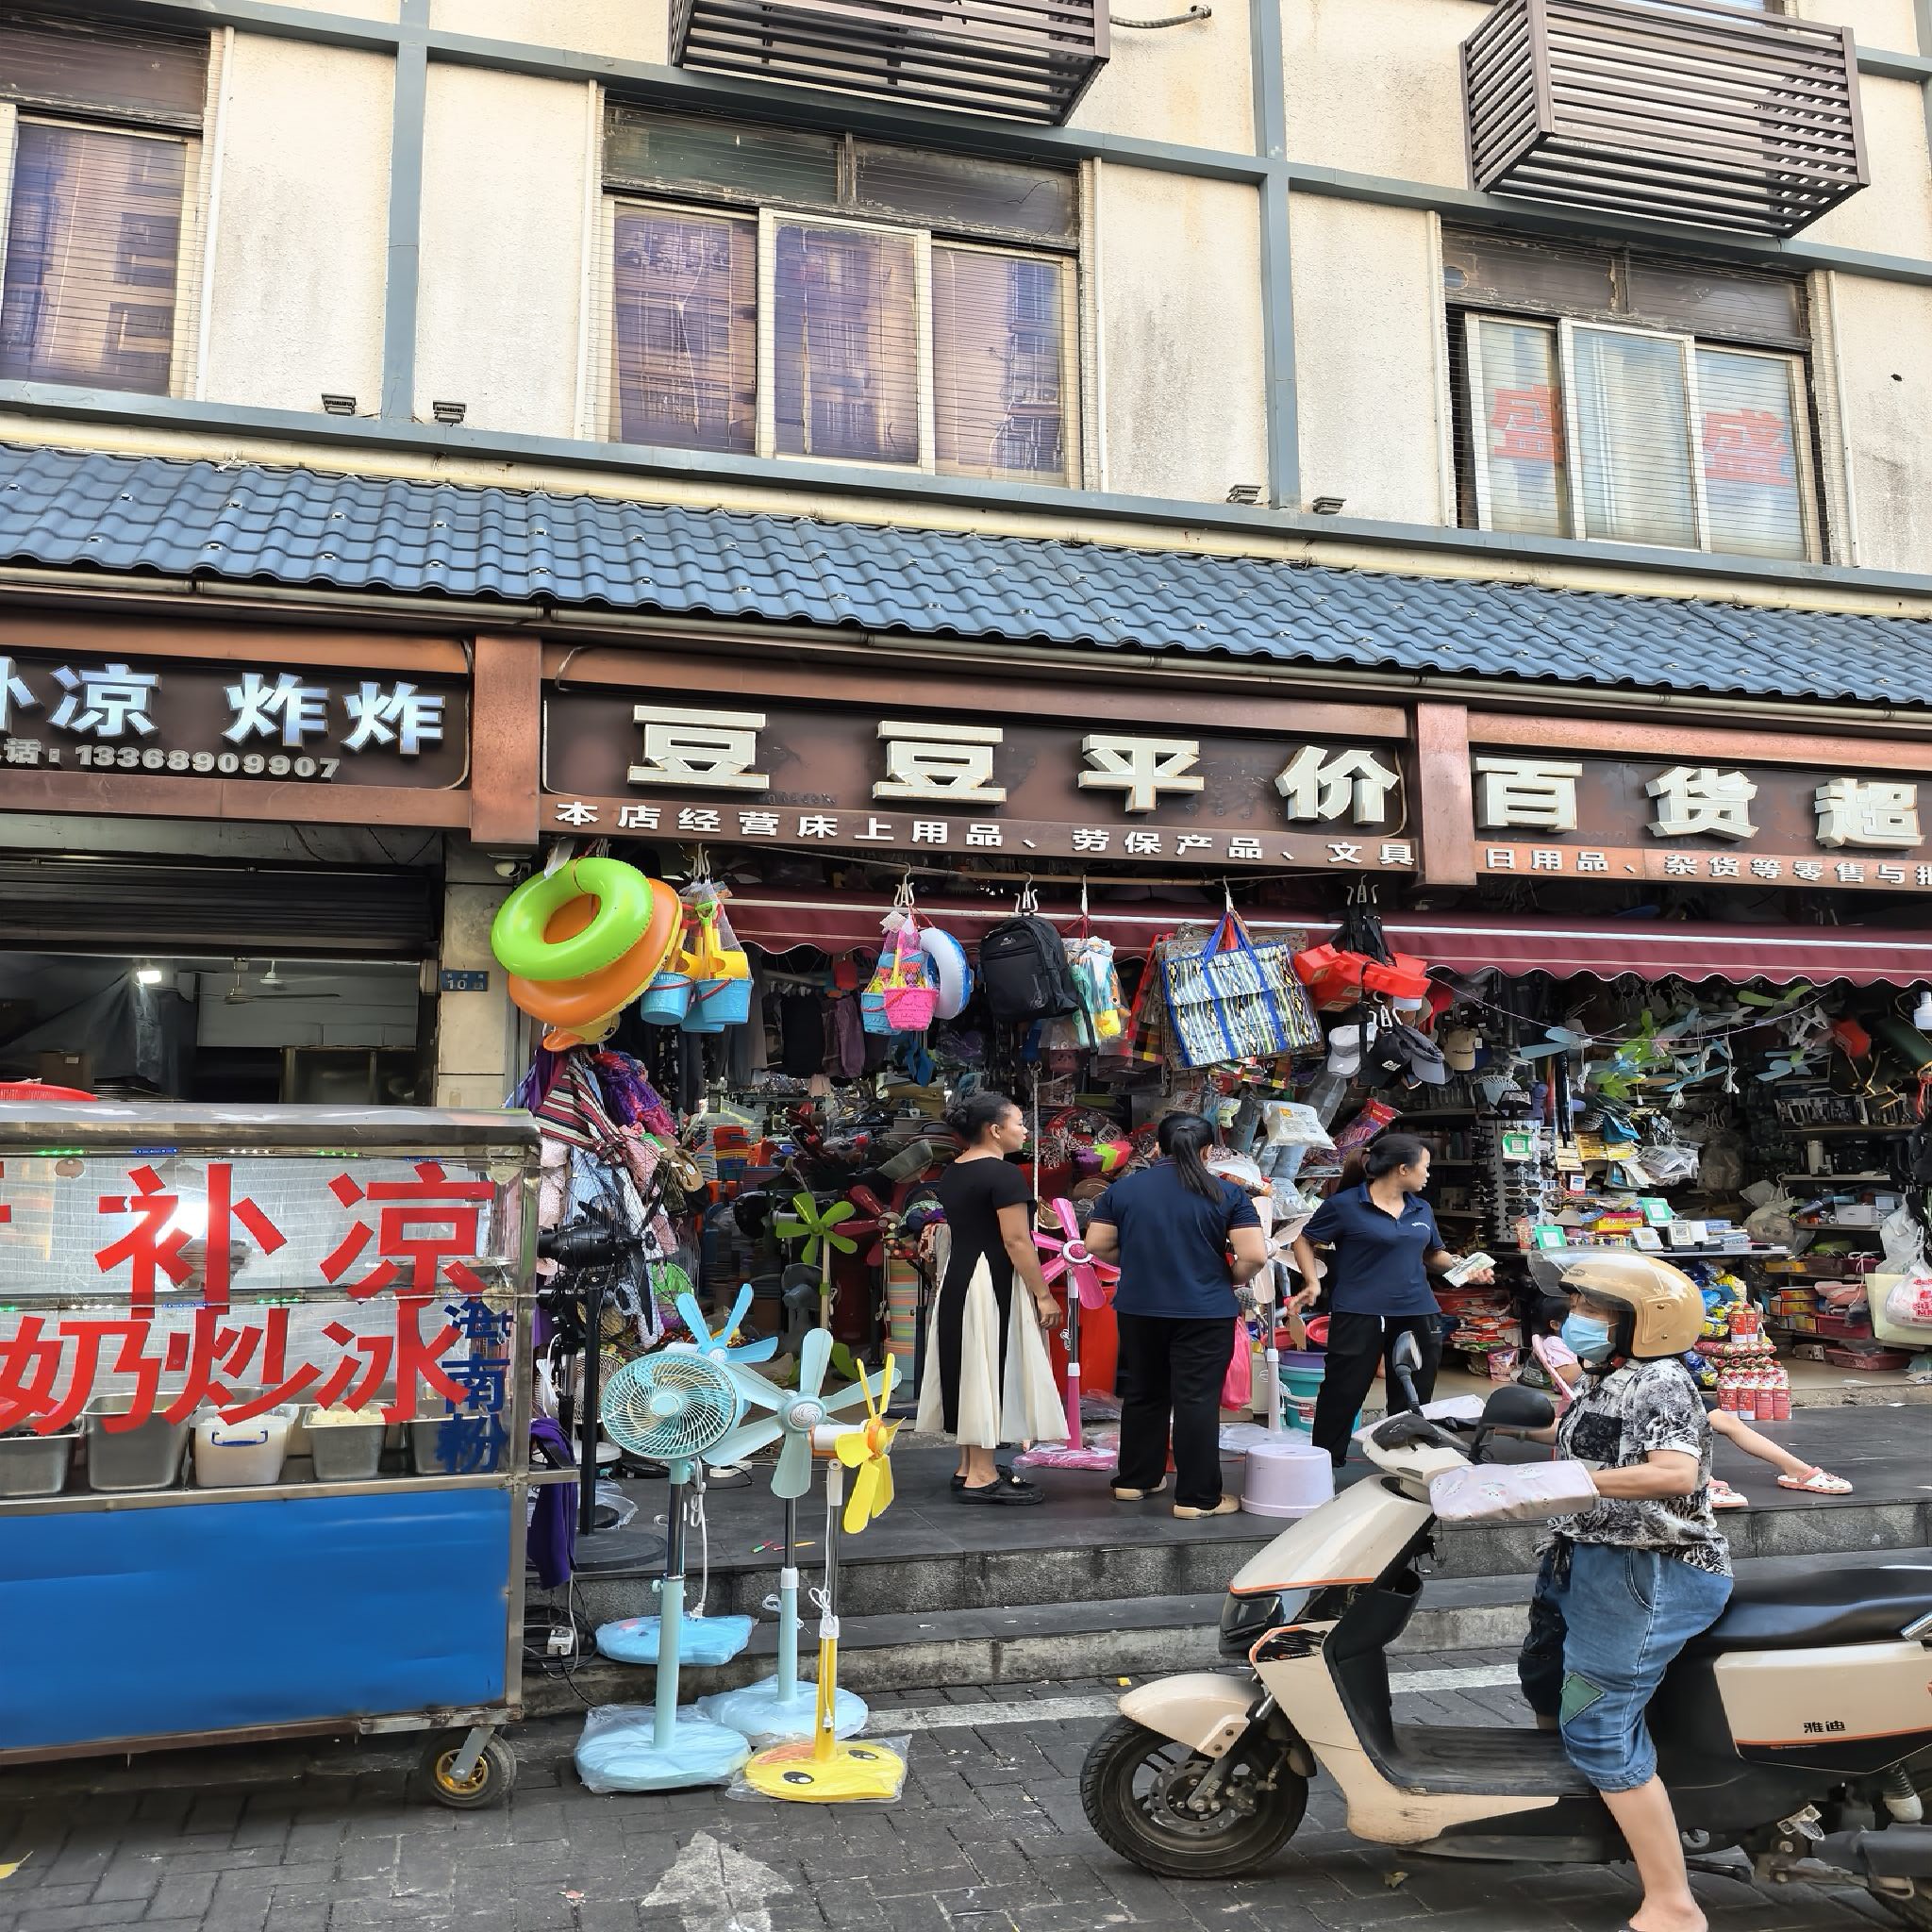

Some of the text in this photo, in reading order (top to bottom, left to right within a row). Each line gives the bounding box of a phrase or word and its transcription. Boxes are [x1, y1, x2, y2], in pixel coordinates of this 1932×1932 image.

[222, 673, 445, 754] 炸炸
[0, 737, 341, 779] 话：13368909907
[627, 705, 1400, 824] 豆豆平价
[556, 801, 1415, 866] 本店经营床上用品、劳保产品、文具
[1473, 758, 1924, 848] 百货超
[0, 1161, 495, 1319] 补凉
[1803, 1720, 1846, 1734] 雅迪
